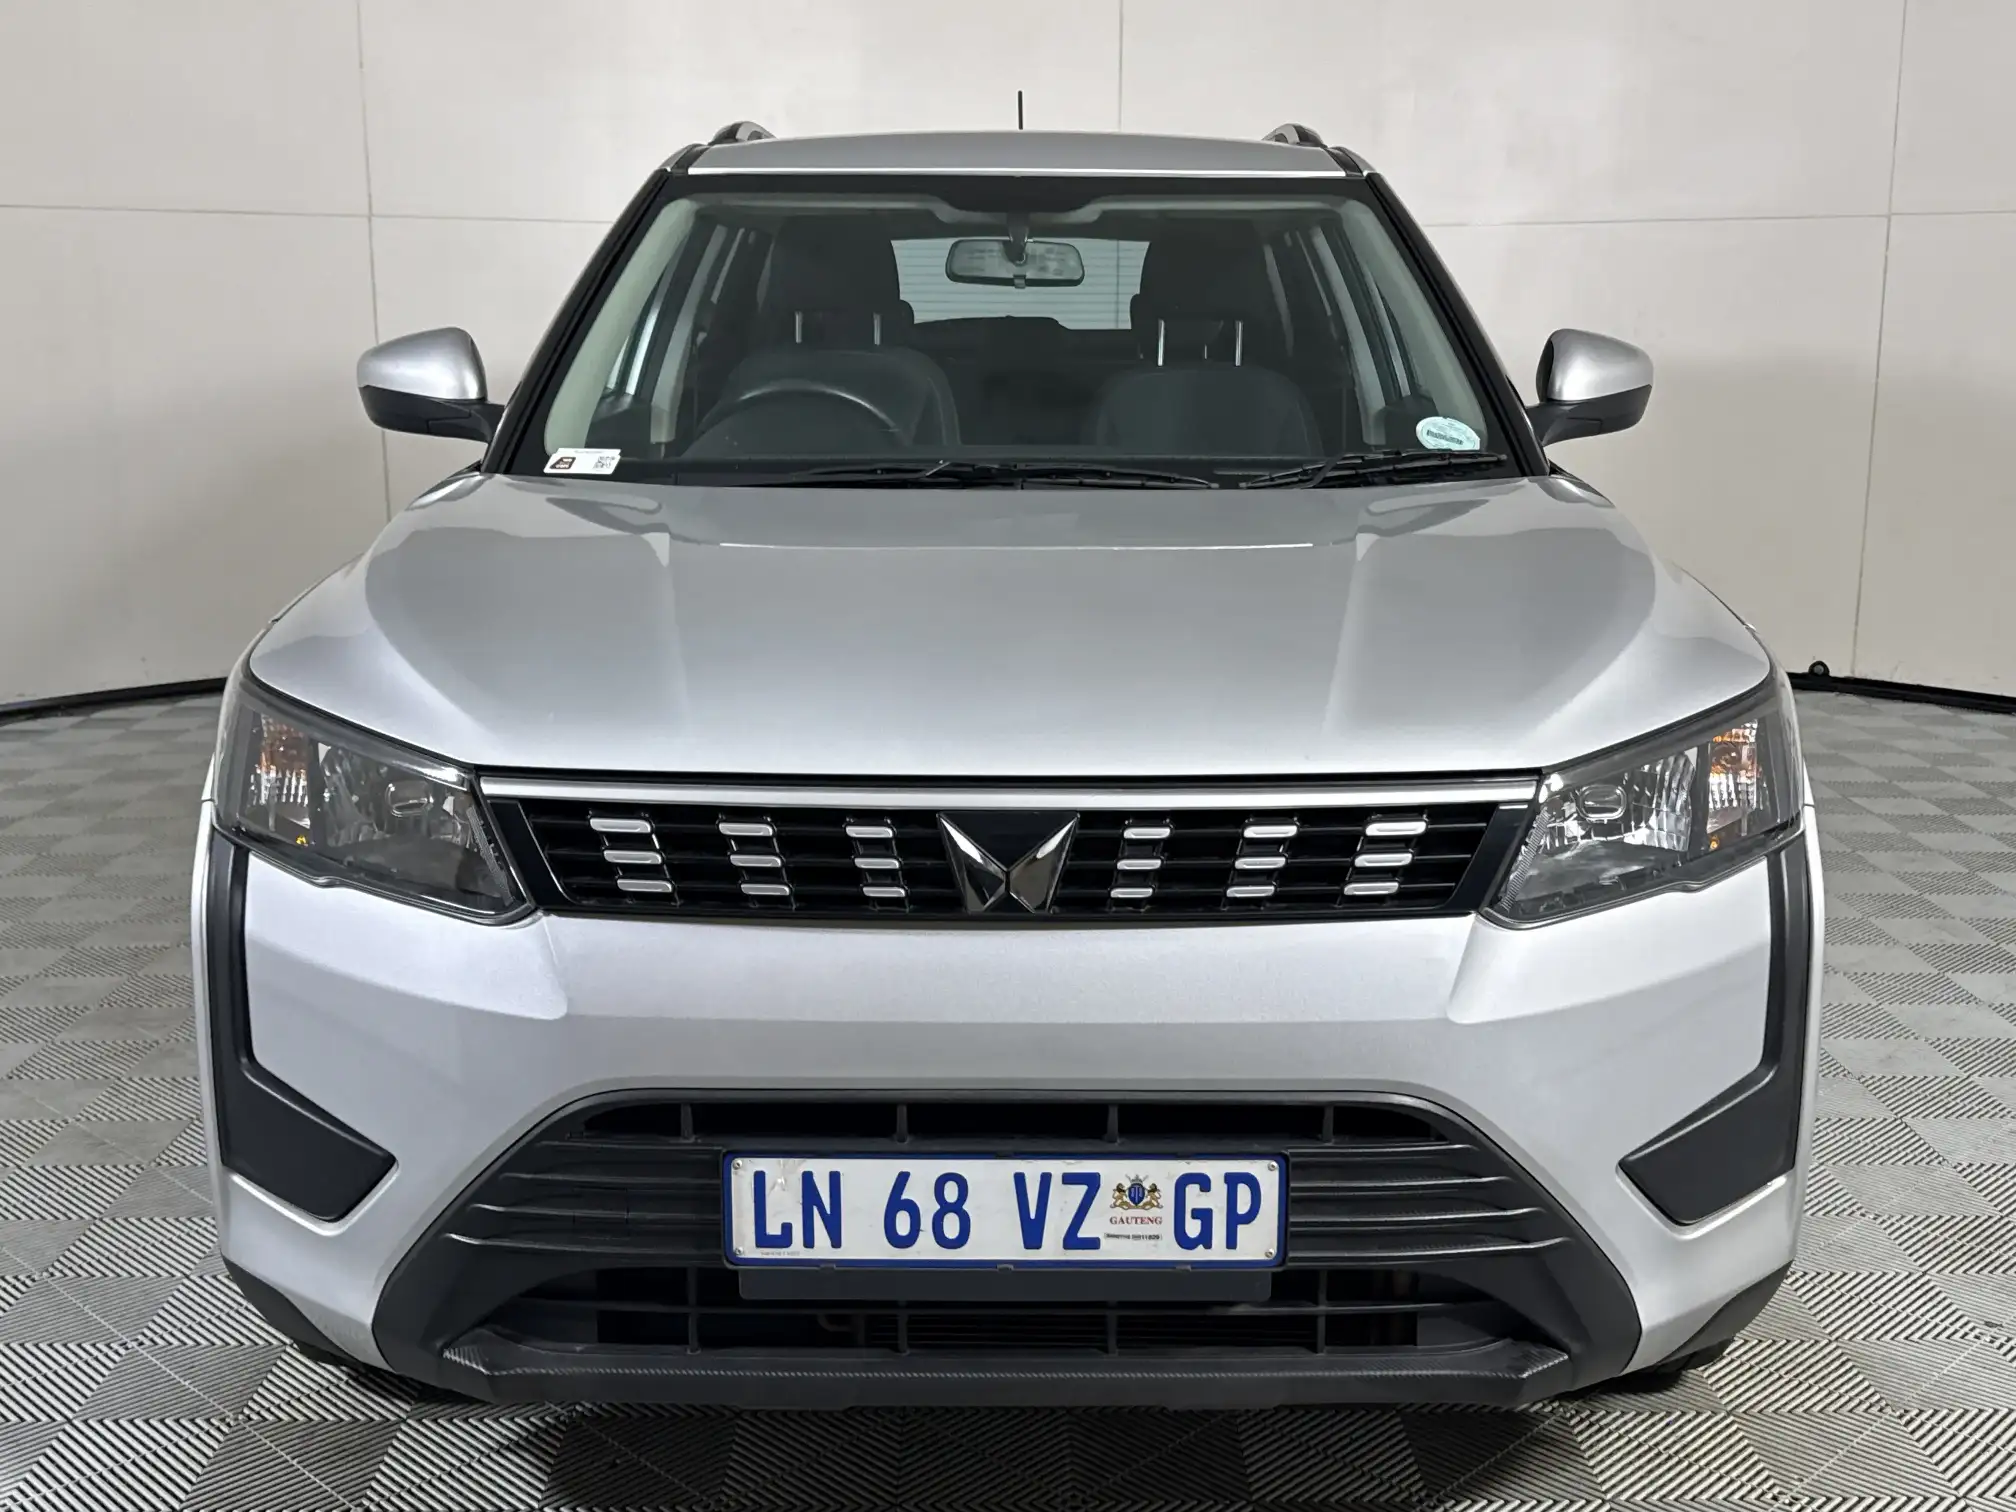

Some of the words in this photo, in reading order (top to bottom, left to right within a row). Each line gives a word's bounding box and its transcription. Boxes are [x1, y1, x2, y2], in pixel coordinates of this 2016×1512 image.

[753, 1170, 842, 1249] LN
[883, 1171, 971, 1249] 68
[1013, 1171, 1101, 1250] VZ
[1173, 1172, 1262, 1251] GP
[1109, 1216, 1163, 1225] GAUTENG
